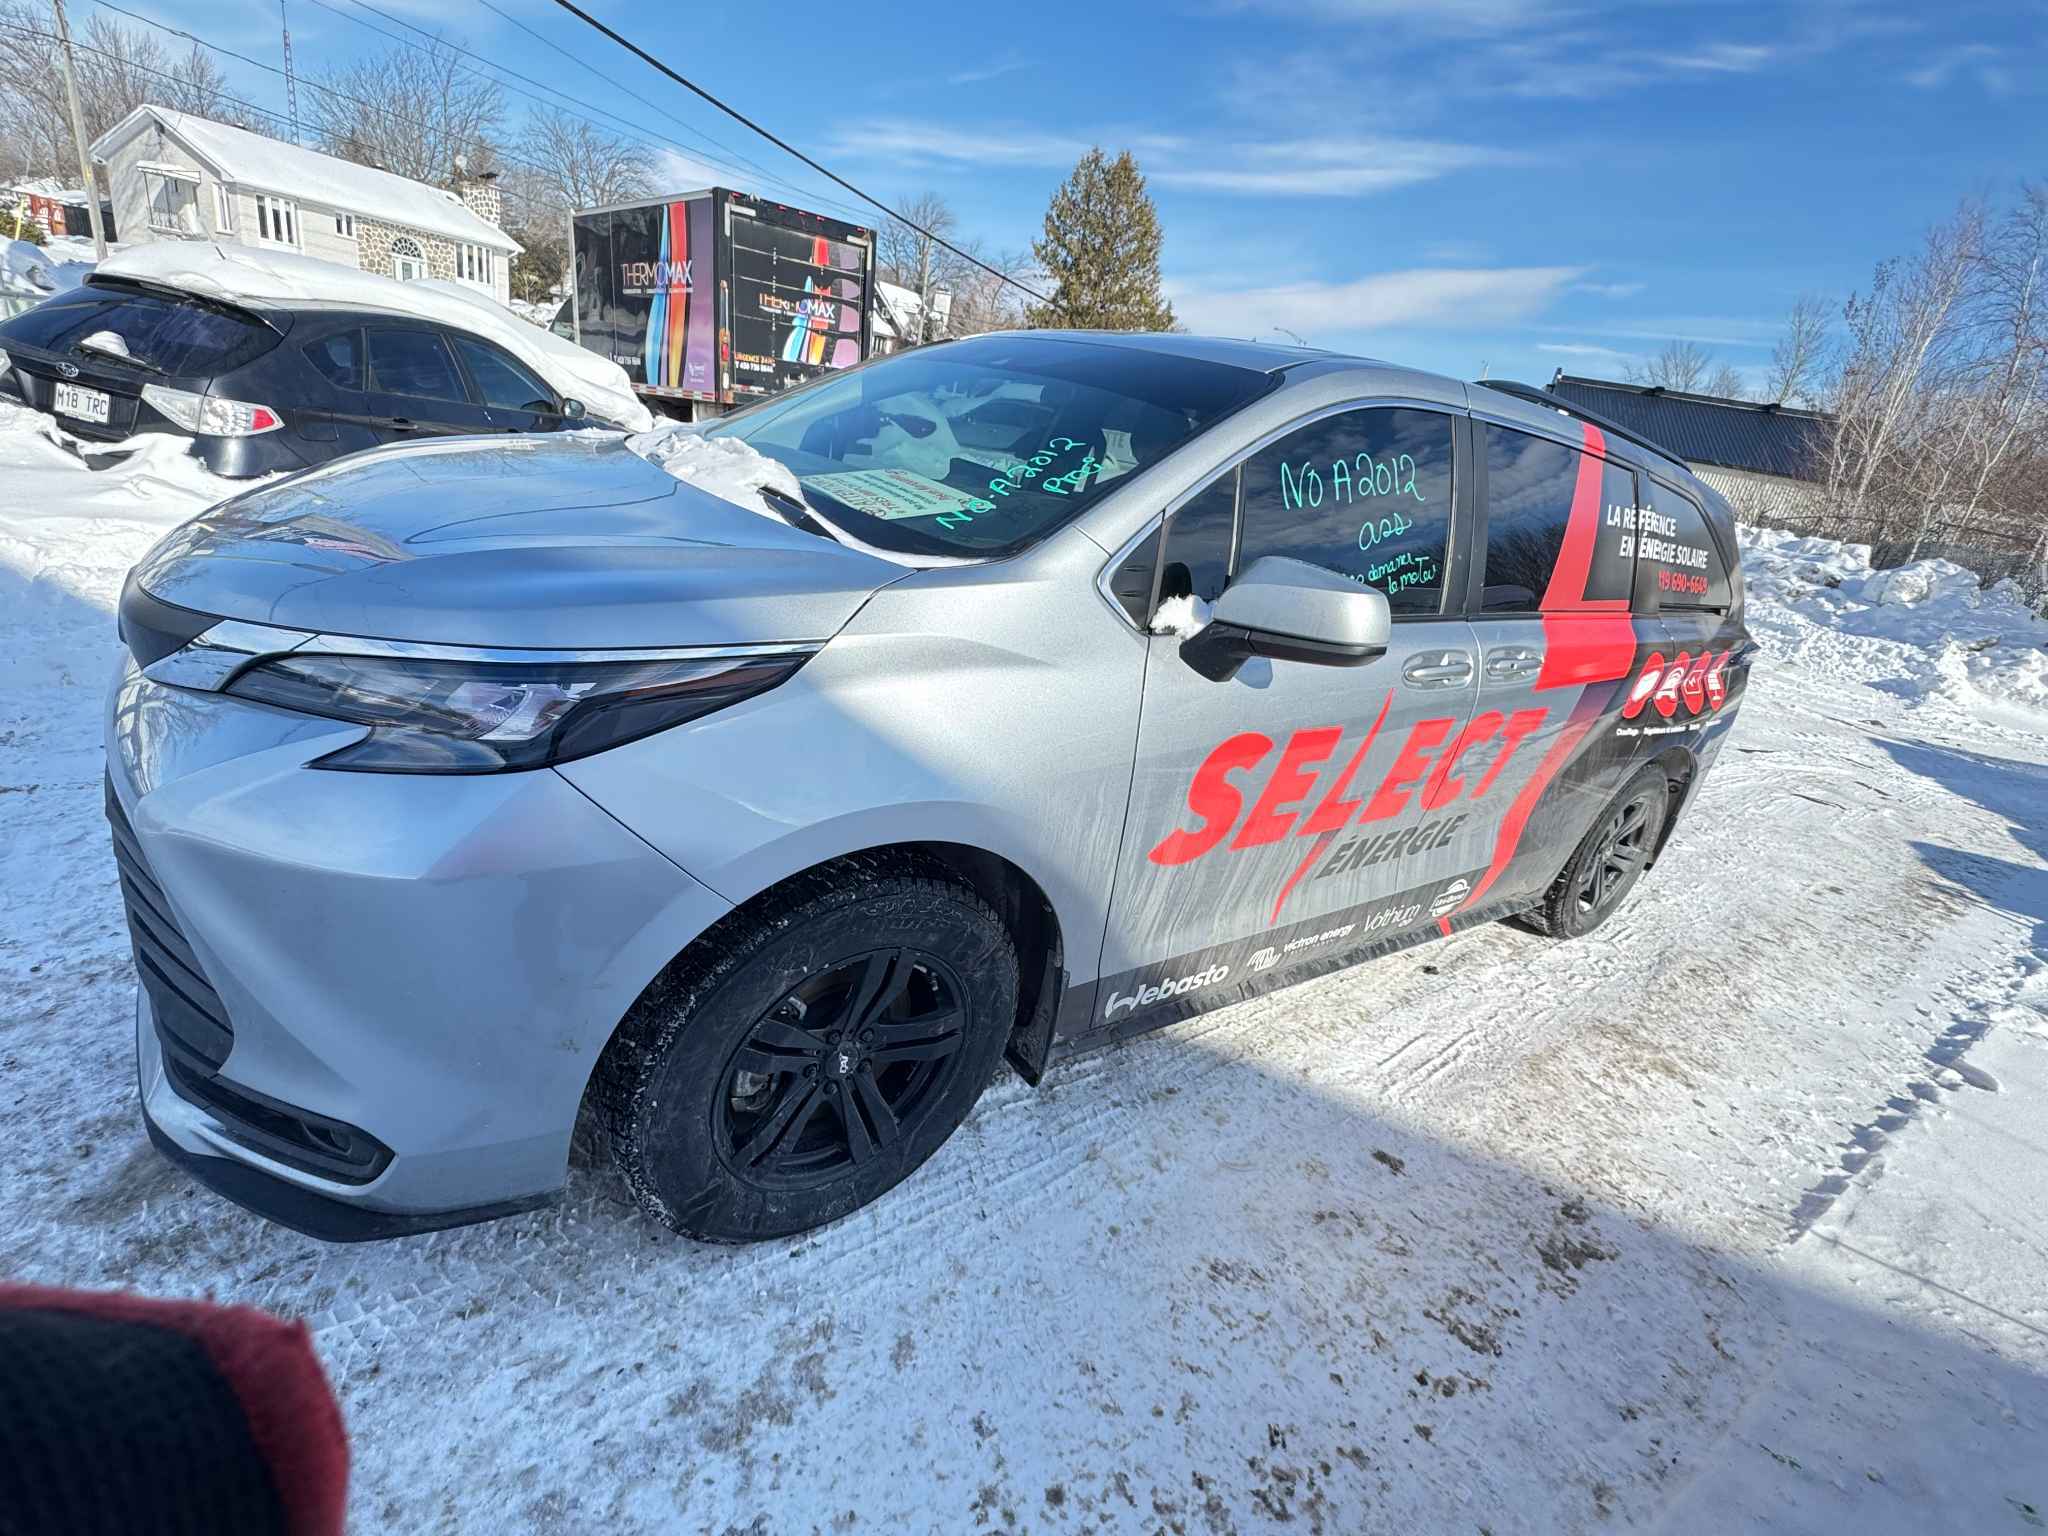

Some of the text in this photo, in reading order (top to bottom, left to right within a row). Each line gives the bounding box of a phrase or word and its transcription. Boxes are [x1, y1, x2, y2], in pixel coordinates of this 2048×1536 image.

[623, 260, 693, 286] THERMOMAX
[57, 389, 107, 415] M18 TRC
[1333, 453, 1426, 504] A2012
[1607, 504, 1621, 527] LA
[1619, 535, 1635, 558] EN
[1676, 544, 1710, 570] SOLAIRE
[1147, 689, 1549, 866] SELECT
[1315, 814, 1469, 880] ÉNERGIE
[1284, 932, 1319, 953] victron
[1319, 923, 1356, 942] energy
[1104, 964, 1230, 1019] Webasto
